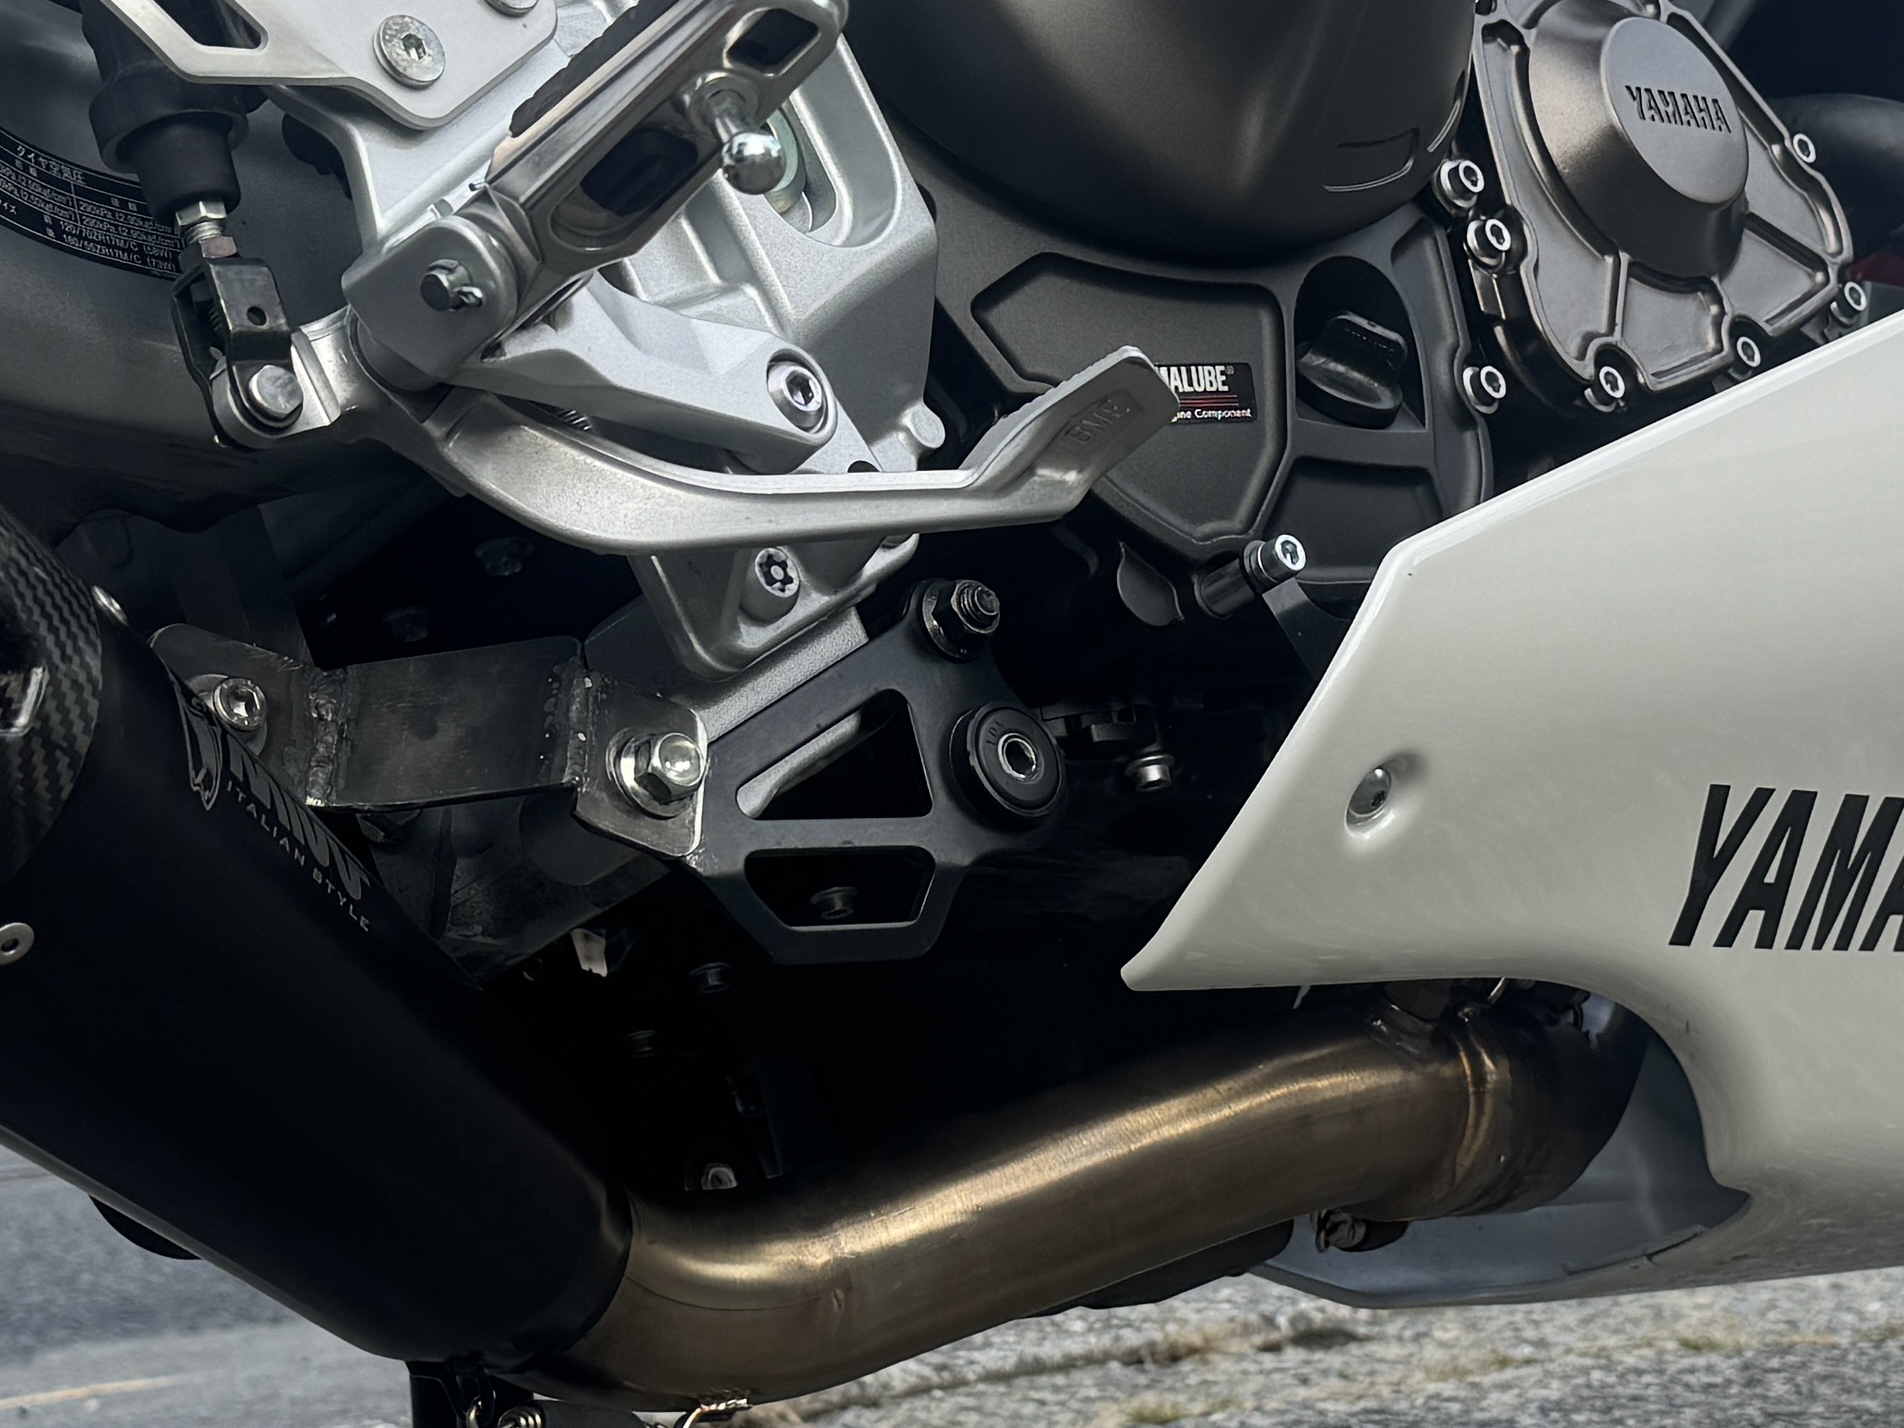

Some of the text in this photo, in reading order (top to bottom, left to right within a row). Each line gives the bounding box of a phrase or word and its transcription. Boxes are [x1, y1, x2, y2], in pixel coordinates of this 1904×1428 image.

[1625, 85, 1732, 134] YAMAHA
[1194, 408, 1252, 421] Component
[227, 780, 368, 932] ITALIAN STYLE
